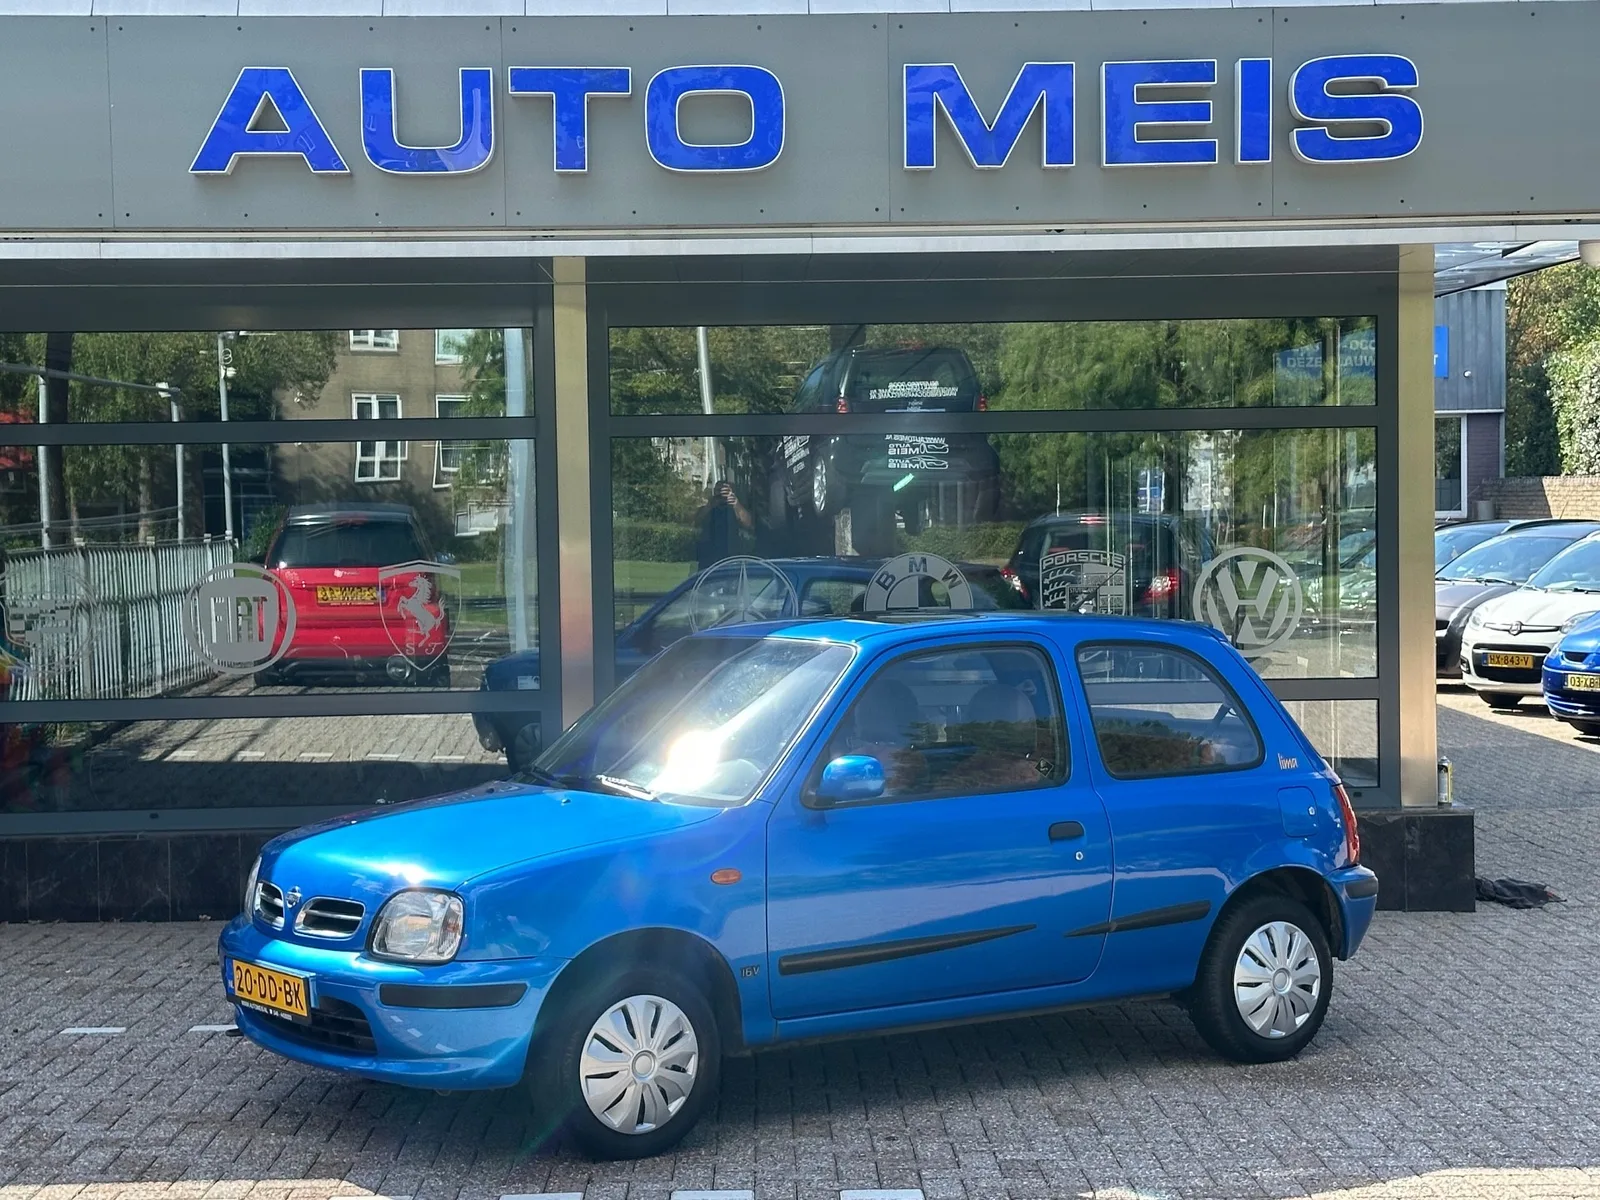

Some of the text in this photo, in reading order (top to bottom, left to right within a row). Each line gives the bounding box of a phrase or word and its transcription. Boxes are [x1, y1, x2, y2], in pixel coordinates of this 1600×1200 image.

[188, 53, 1424, 175] AUTO MEIS
[1042, 552, 1123, 570] PORSCHE
[210, 596, 268, 643] FIAT
[1569, 676, 1600, 688] 03-XB-
[742, 966, 760, 977] 16V
[236, 965, 304, 1010] 20-DD-BK
